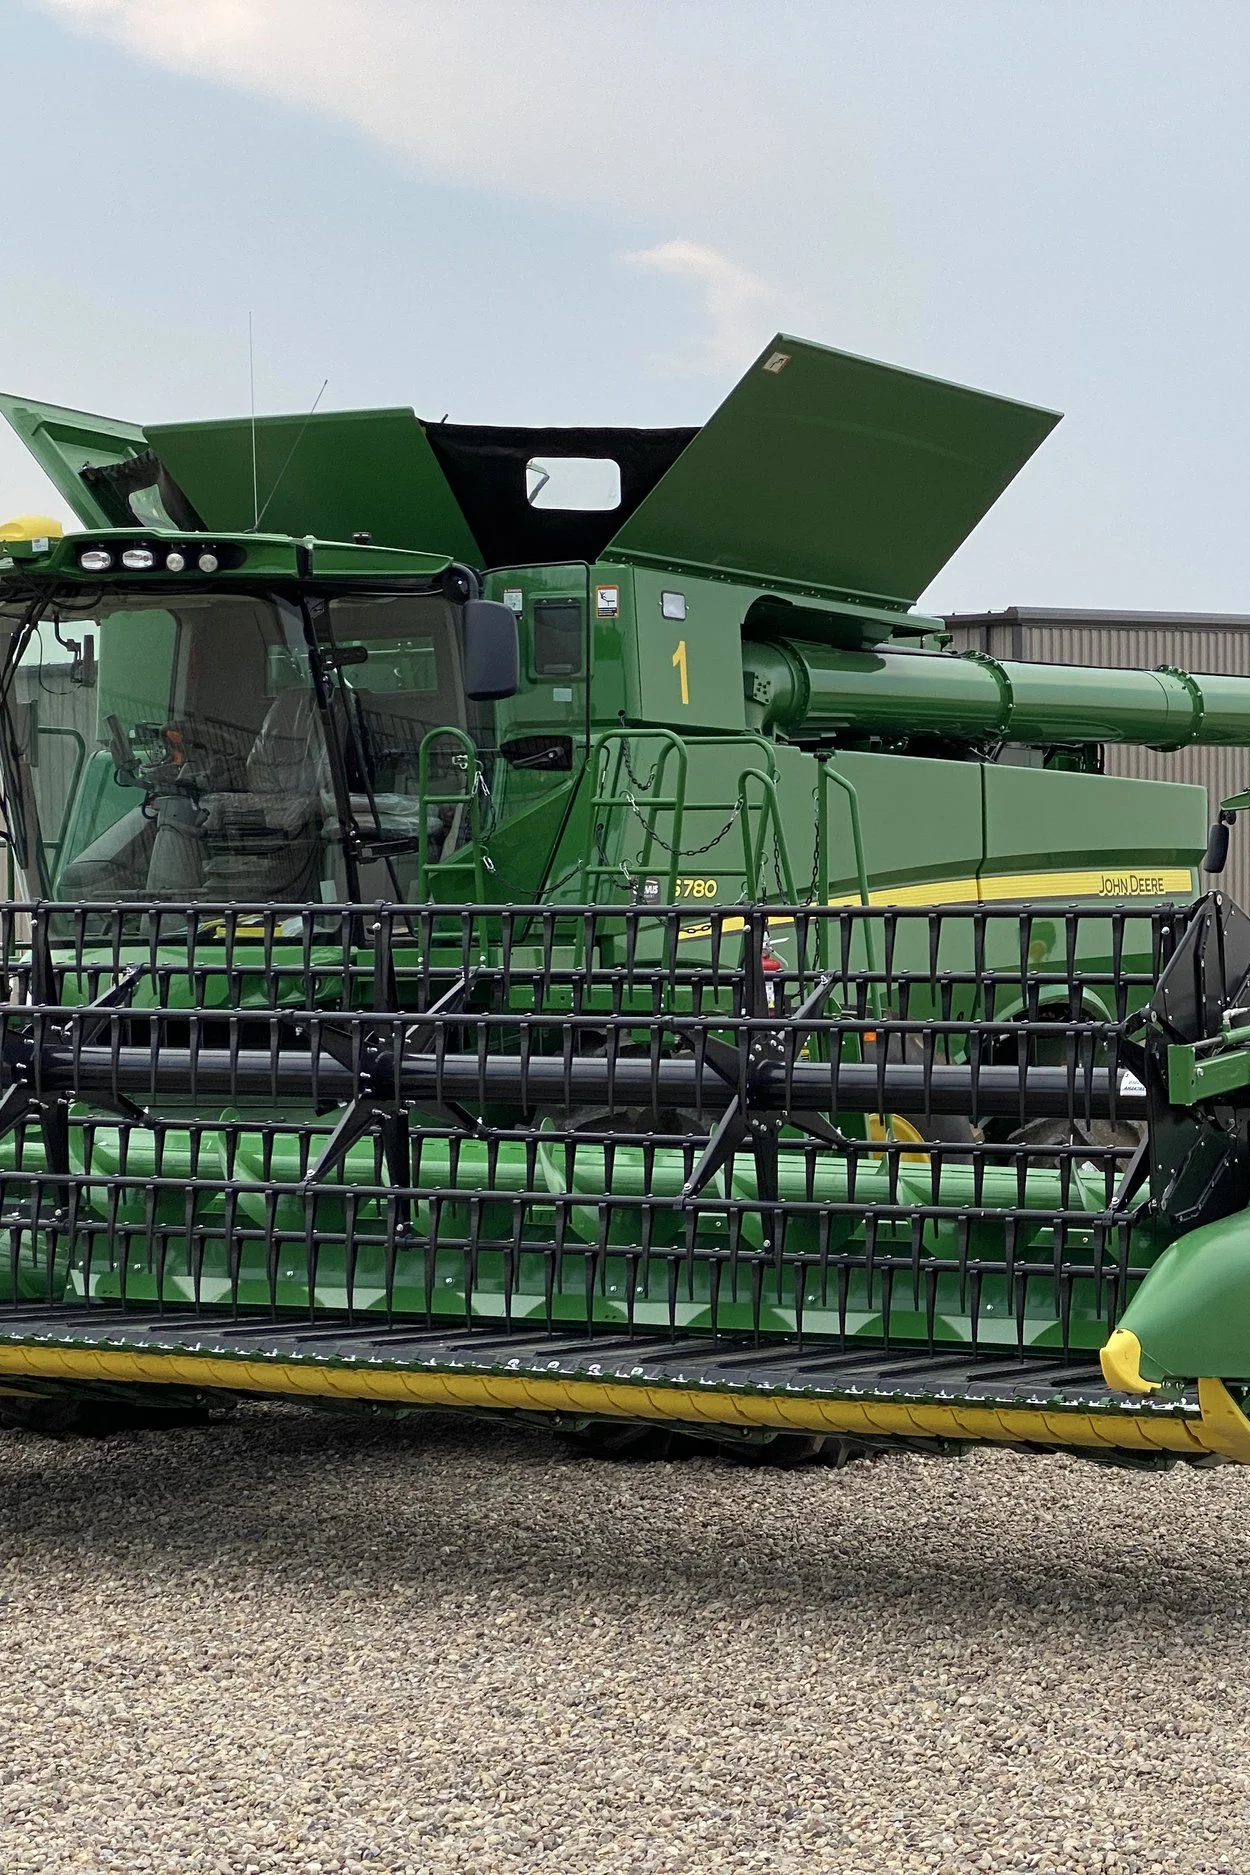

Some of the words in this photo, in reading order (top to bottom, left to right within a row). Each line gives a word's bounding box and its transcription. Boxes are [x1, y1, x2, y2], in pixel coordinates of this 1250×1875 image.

[672, 640, 690, 704] 1
[1099, 874, 1128, 893] JOHN
[1130, 874, 1165, 892] DEERE
